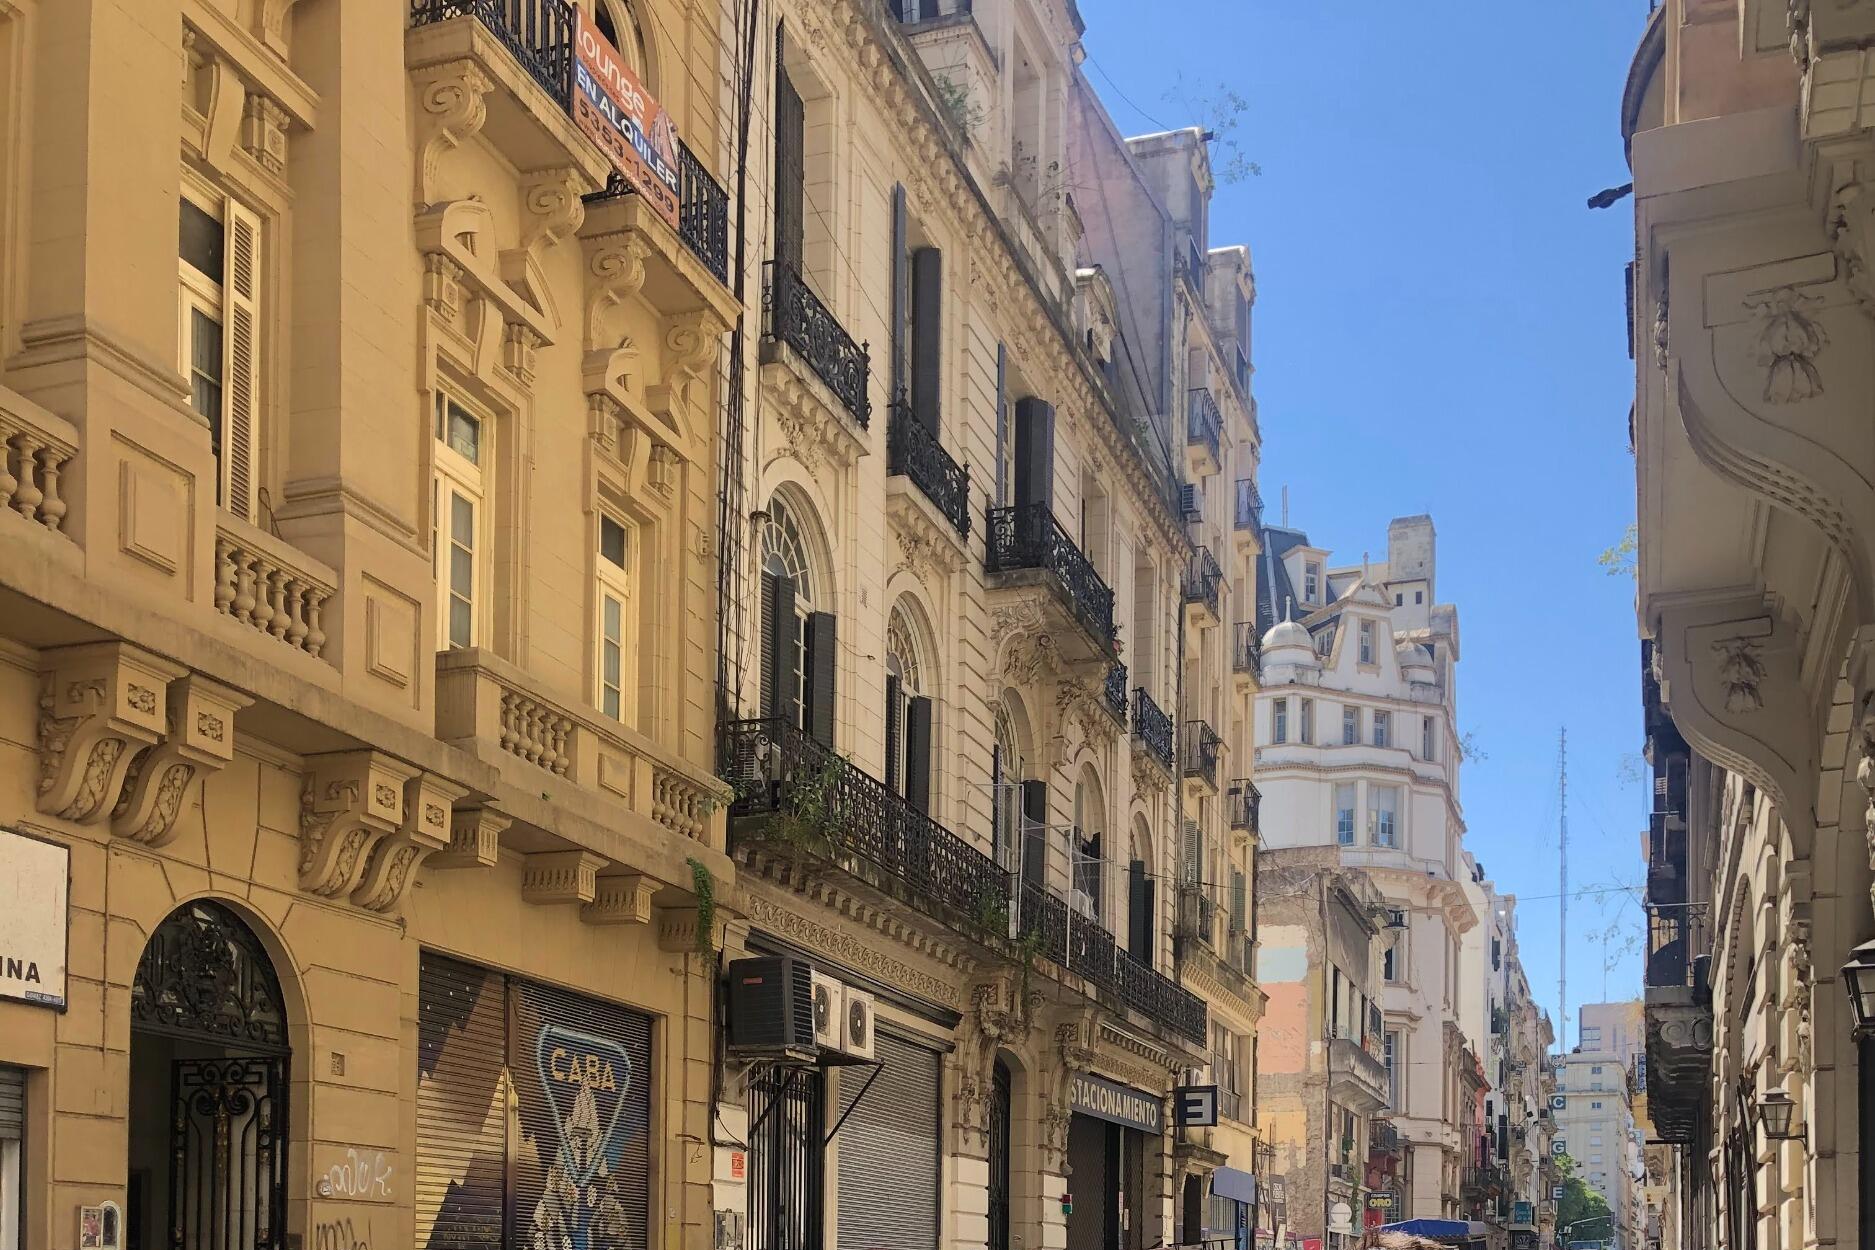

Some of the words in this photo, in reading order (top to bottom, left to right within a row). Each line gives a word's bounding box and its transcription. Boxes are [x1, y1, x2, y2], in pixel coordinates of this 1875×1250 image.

[577, 11, 646, 119] lounge
[577, 67, 597, 101] EN
[600, 96, 677, 192] ALQUILER
[579, 98, 675, 213] 5353-1299
[551, 1047, 616, 1092] CABA
[1071, 1078, 1157, 1127] STACIONAMIENTO
